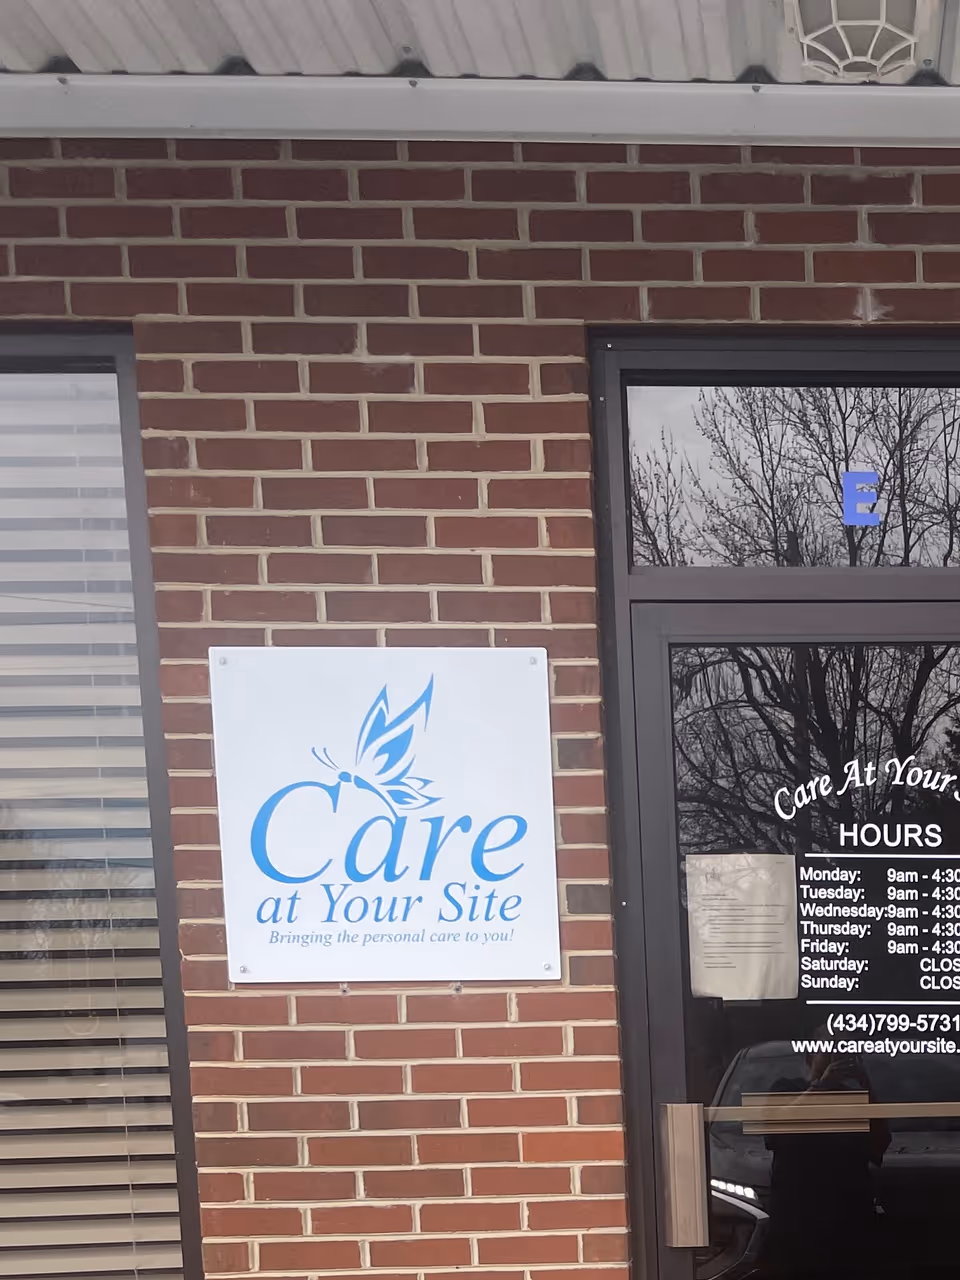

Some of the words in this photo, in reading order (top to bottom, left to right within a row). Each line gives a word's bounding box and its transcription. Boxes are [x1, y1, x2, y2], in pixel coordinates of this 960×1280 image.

[842, 471, 881, 526] E
[774, 775, 833, 820] Care
[836, 759, 877, 796] At
[886, 755, 957, 794] Your
[250, 781, 528, 884] Care
[839, 823, 943, 848] HOURS
[800, 867, 861, 884] Monday:
[887, 869, 919, 883] 9am
[800, 885, 866, 902] Tuesday:
[887, 887, 919, 901] 9am
[256, 889, 300, 924] at
[321, 883, 423, 924] Your
[438, 882, 523, 924] Site
[269, 931, 333, 947] Bringing
[337, 930, 360, 943] the
[363, 930, 425, 946] personal
[430, 932, 460, 943] care
[465, 930, 479, 942] to
[482, 929, 514, 946] you!
[801, 921, 871, 938] Thursday:
[887, 923, 919, 937] 9am
[801, 939, 850, 956] Friday:
[887, 941, 919, 955] 9am
[801, 957, 869, 974] Saturday:
[801, 975, 860, 992] Sunday:
